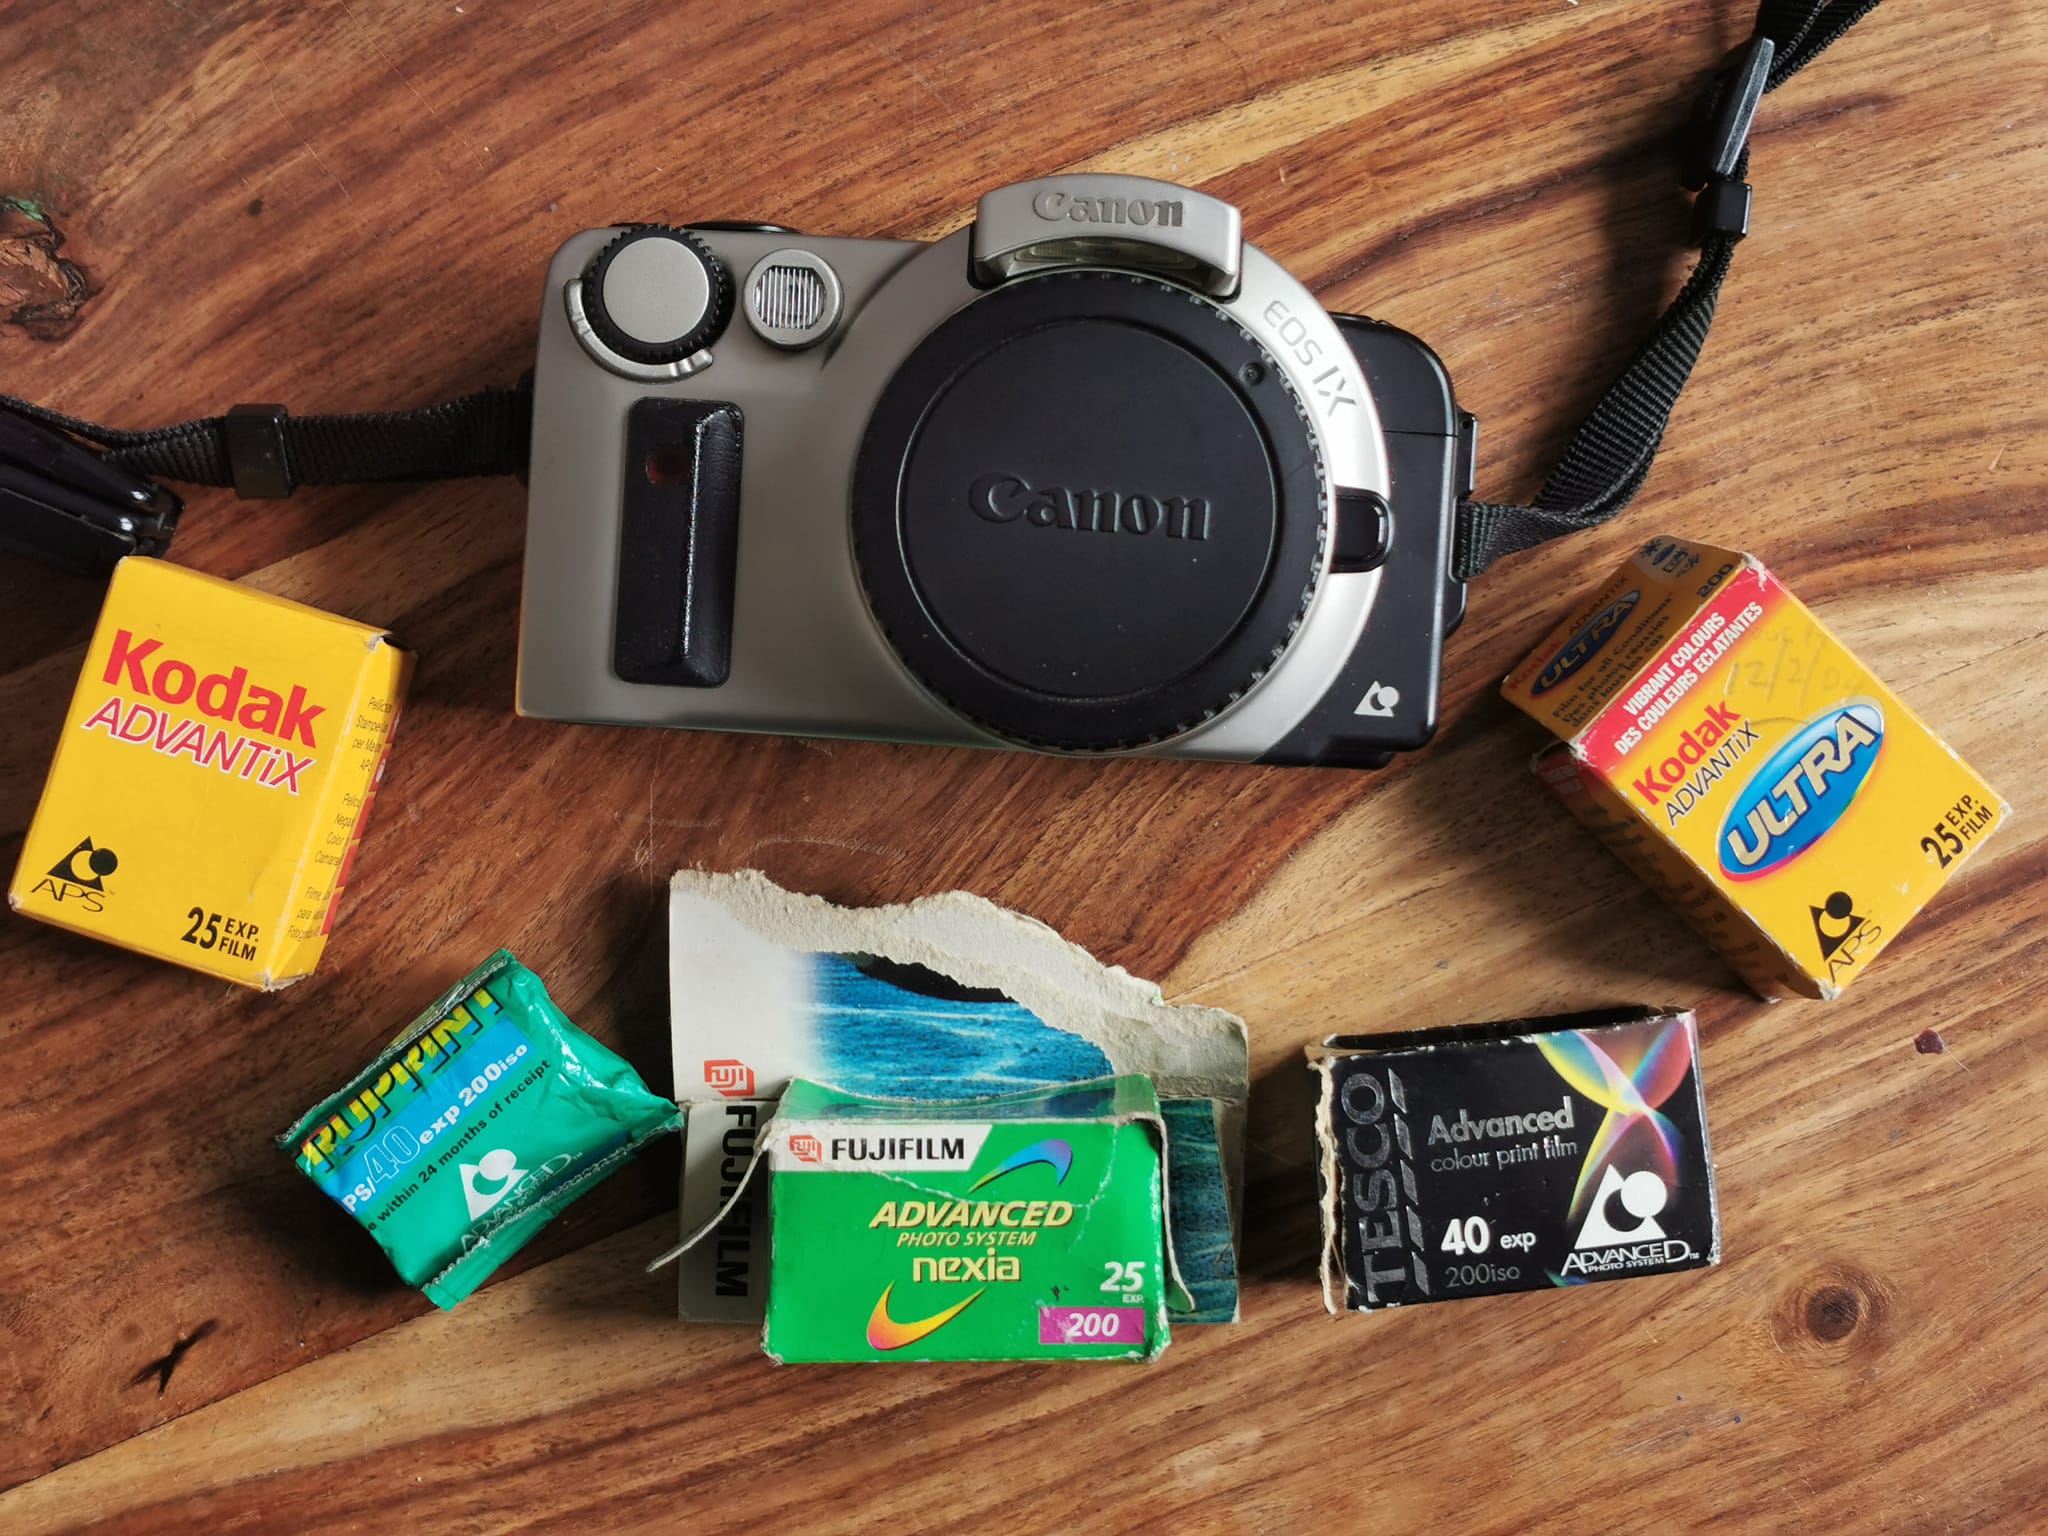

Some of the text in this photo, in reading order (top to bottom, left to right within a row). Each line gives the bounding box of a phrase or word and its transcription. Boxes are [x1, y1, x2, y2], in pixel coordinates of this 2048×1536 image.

[1032, 189, 1186, 229] Canon
[1262, 300, 1357, 417] EOS IX
[967, 472, 1212, 541] Canon
[1697, 563, 1735, 598] 200
[1541, 600, 1633, 689] ULTRA
[1622, 611, 1726, 718] VIBRANT COLOURS
[102, 628, 327, 749] Kodak
[1613, 725, 1643, 756] DES
[1636, 668, 1699, 733] COULEURS
[1694, 601, 1764, 674] ECLATANTES
[1632, 700, 1742, 805] Kodak
[1726, 711, 1878, 867] ULTRA
[1920, 806, 1993, 871] 25 FILM
[31, 877, 106, 912] APS
[181, 906, 223, 950] 25
[219, 936, 257, 962] FILM
[1828, 922, 1883, 984] APS
[458, 1044, 528, 1107] 200iso
[377, 1183, 420, 1222] within
[418, 1164, 438, 1184] 24
[438, 1120, 488, 1167] months
[488, 1100, 504, 1120] of
[504, 1059, 552, 1105] receipt
[1427, 1096, 1576, 1146] Advanced
[831, 1137, 965, 1162] FUJIFILM
[1430, 1136, 1578, 1173] colour print film
[715, 1105, 757, 1297] FUJIFILM
[1341, 1072, 1406, 1302] TESCO
[868, 1200, 1074, 1230] ADVANCED
[1441, 1216, 1537, 1256] 40 exp
[896, 1231, 1037, 1248] PHOTO SYSTEM
[1560, 1239, 1691, 1277] ADVANCED
[912, 1247, 1022, 1283] nexia
[1099, 1261, 1146, 1293] 25
[1445, 1262, 1521, 1289] 200iso
[1588, 1256, 1666, 1274] PHOTO SYSTEM
[1065, 1312, 1120, 1340] 200
